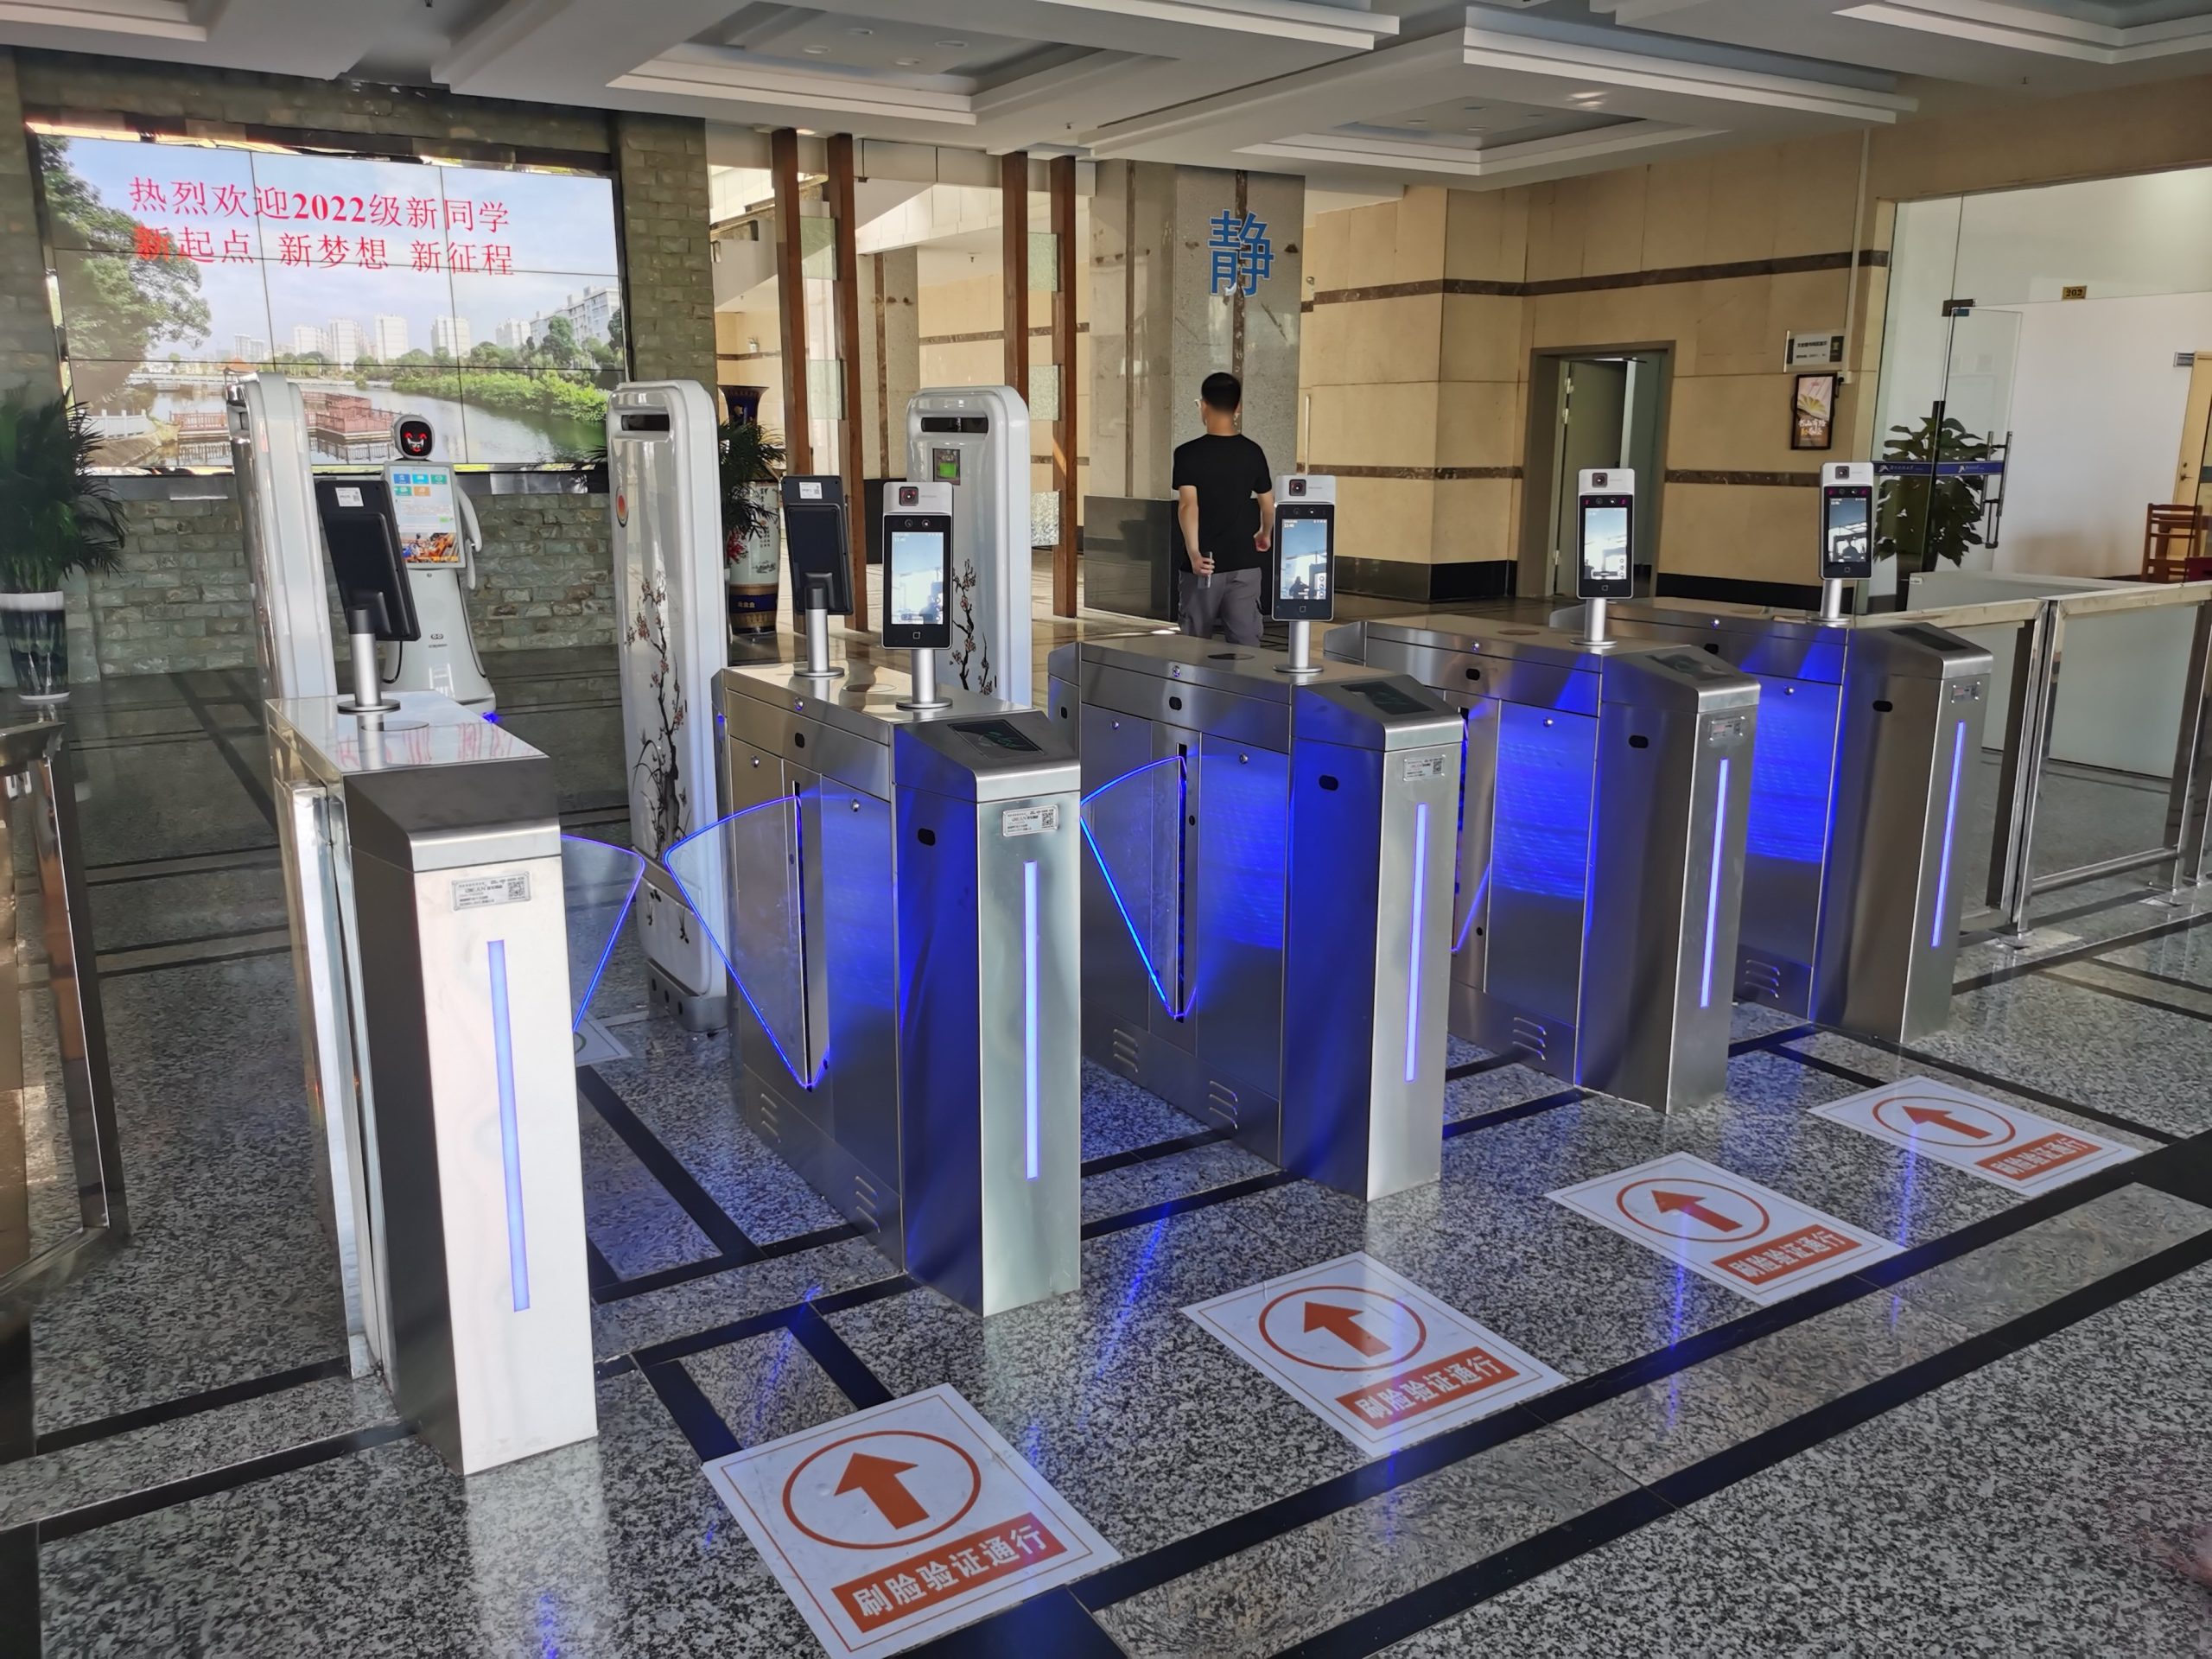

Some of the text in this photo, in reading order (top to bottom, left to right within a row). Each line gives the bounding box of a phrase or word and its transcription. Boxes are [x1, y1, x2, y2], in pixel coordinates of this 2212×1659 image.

[130, 176, 510, 233] 热烈欢迎2022级新同学
[135, 224, 516, 276] 新起点 新梦想 新征程
[1208, 209, 1275, 297] 静
[1354, 1355, 1503, 1420] 刷脸验证通行
[851, 1523, 1047, 1618] 刷脸验证通行
